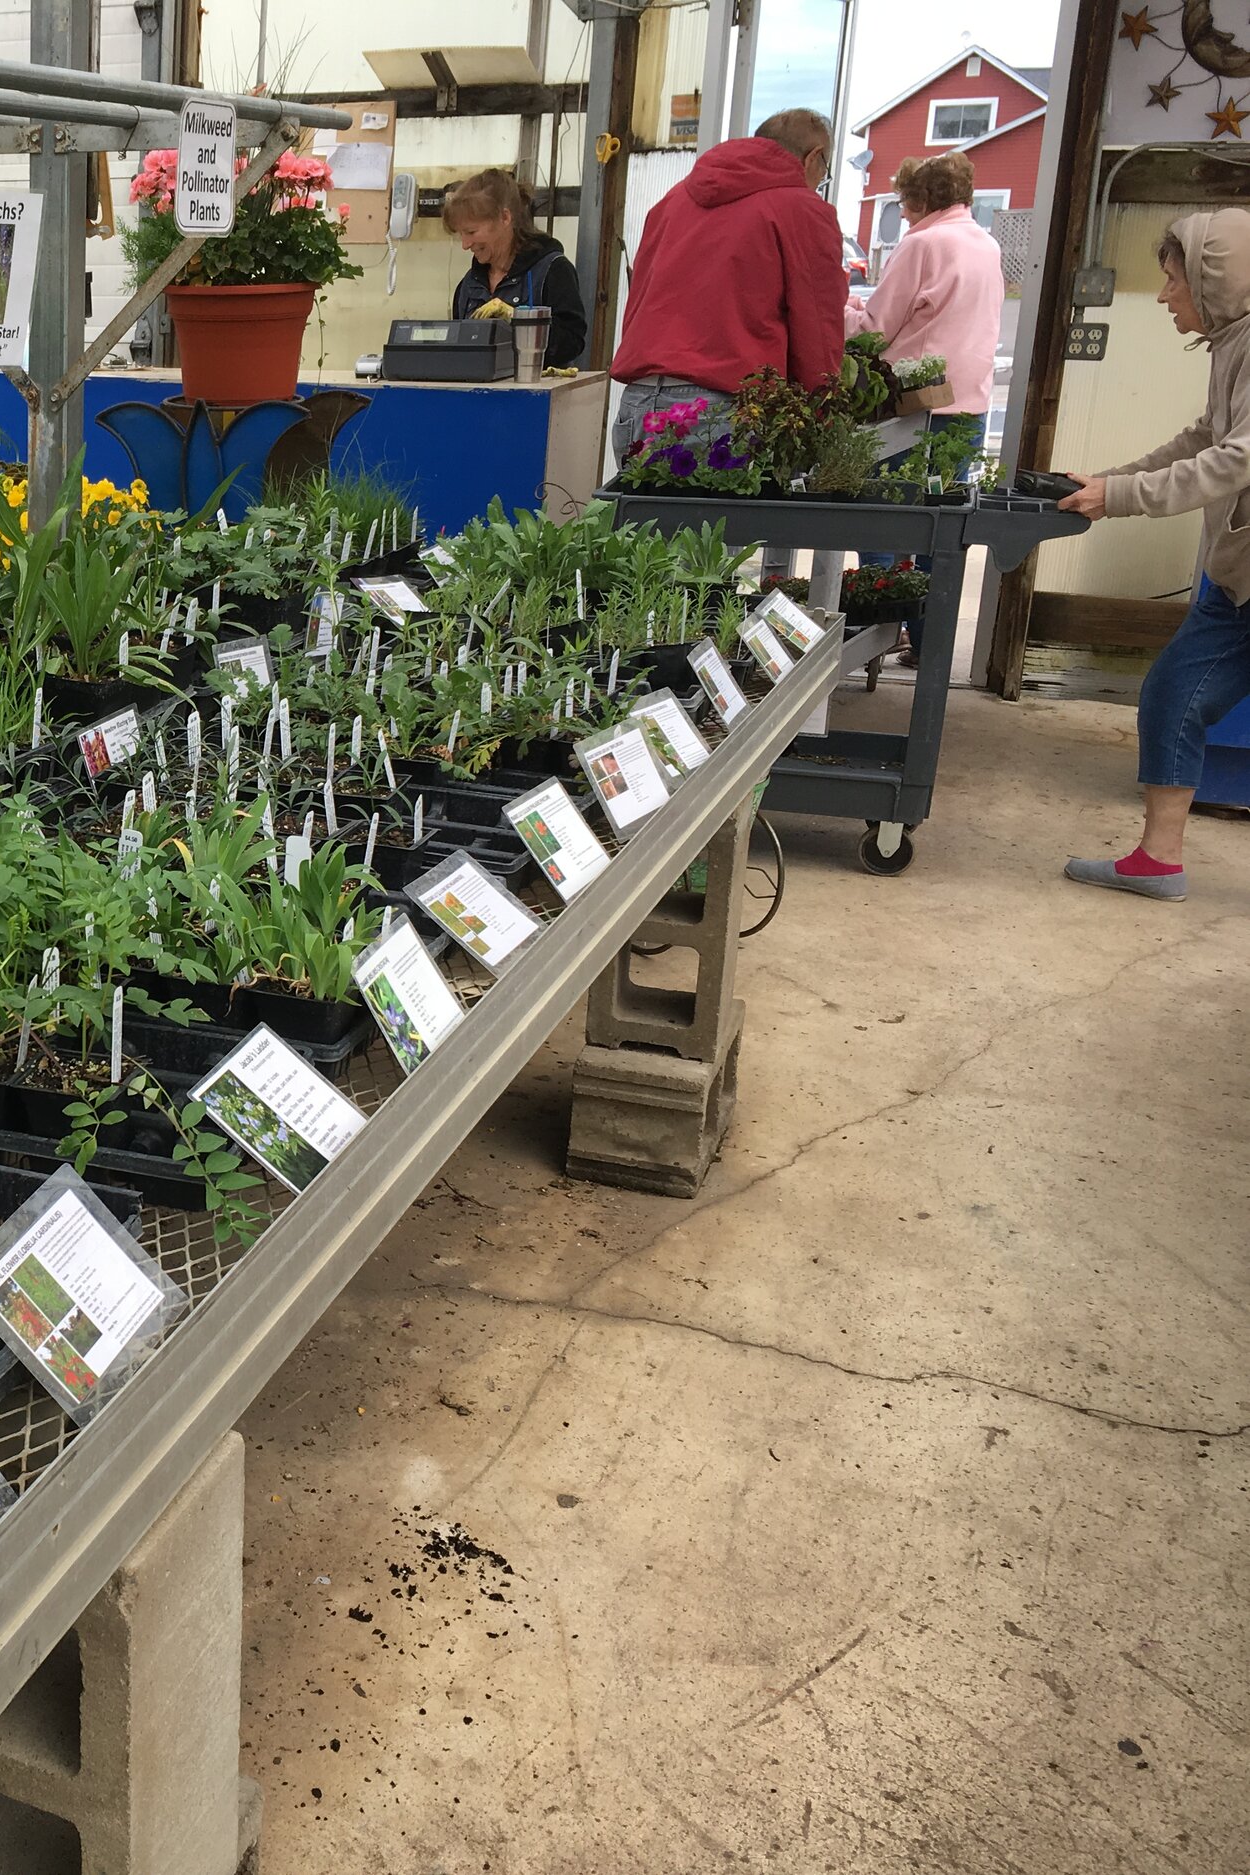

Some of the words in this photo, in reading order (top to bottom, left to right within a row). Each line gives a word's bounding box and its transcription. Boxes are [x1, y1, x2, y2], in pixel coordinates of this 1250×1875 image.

[184, 112, 233, 138] Milkweed
[675, 126, 698, 136] VISA
[197, 144, 216, 165] and
[181, 171, 230, 194] Pollinator
[189, 200, 220, 222] Plants
[238, 1050, 257, 1070] Jacob's
[252, 1036, 270, 1055] Ladder
[0, 1253, 21, 1274] FLOWER
[15, 1234, 40, 1258] (LOBELIA
[33, 1209, 64, 1239] CARDINALIS)
